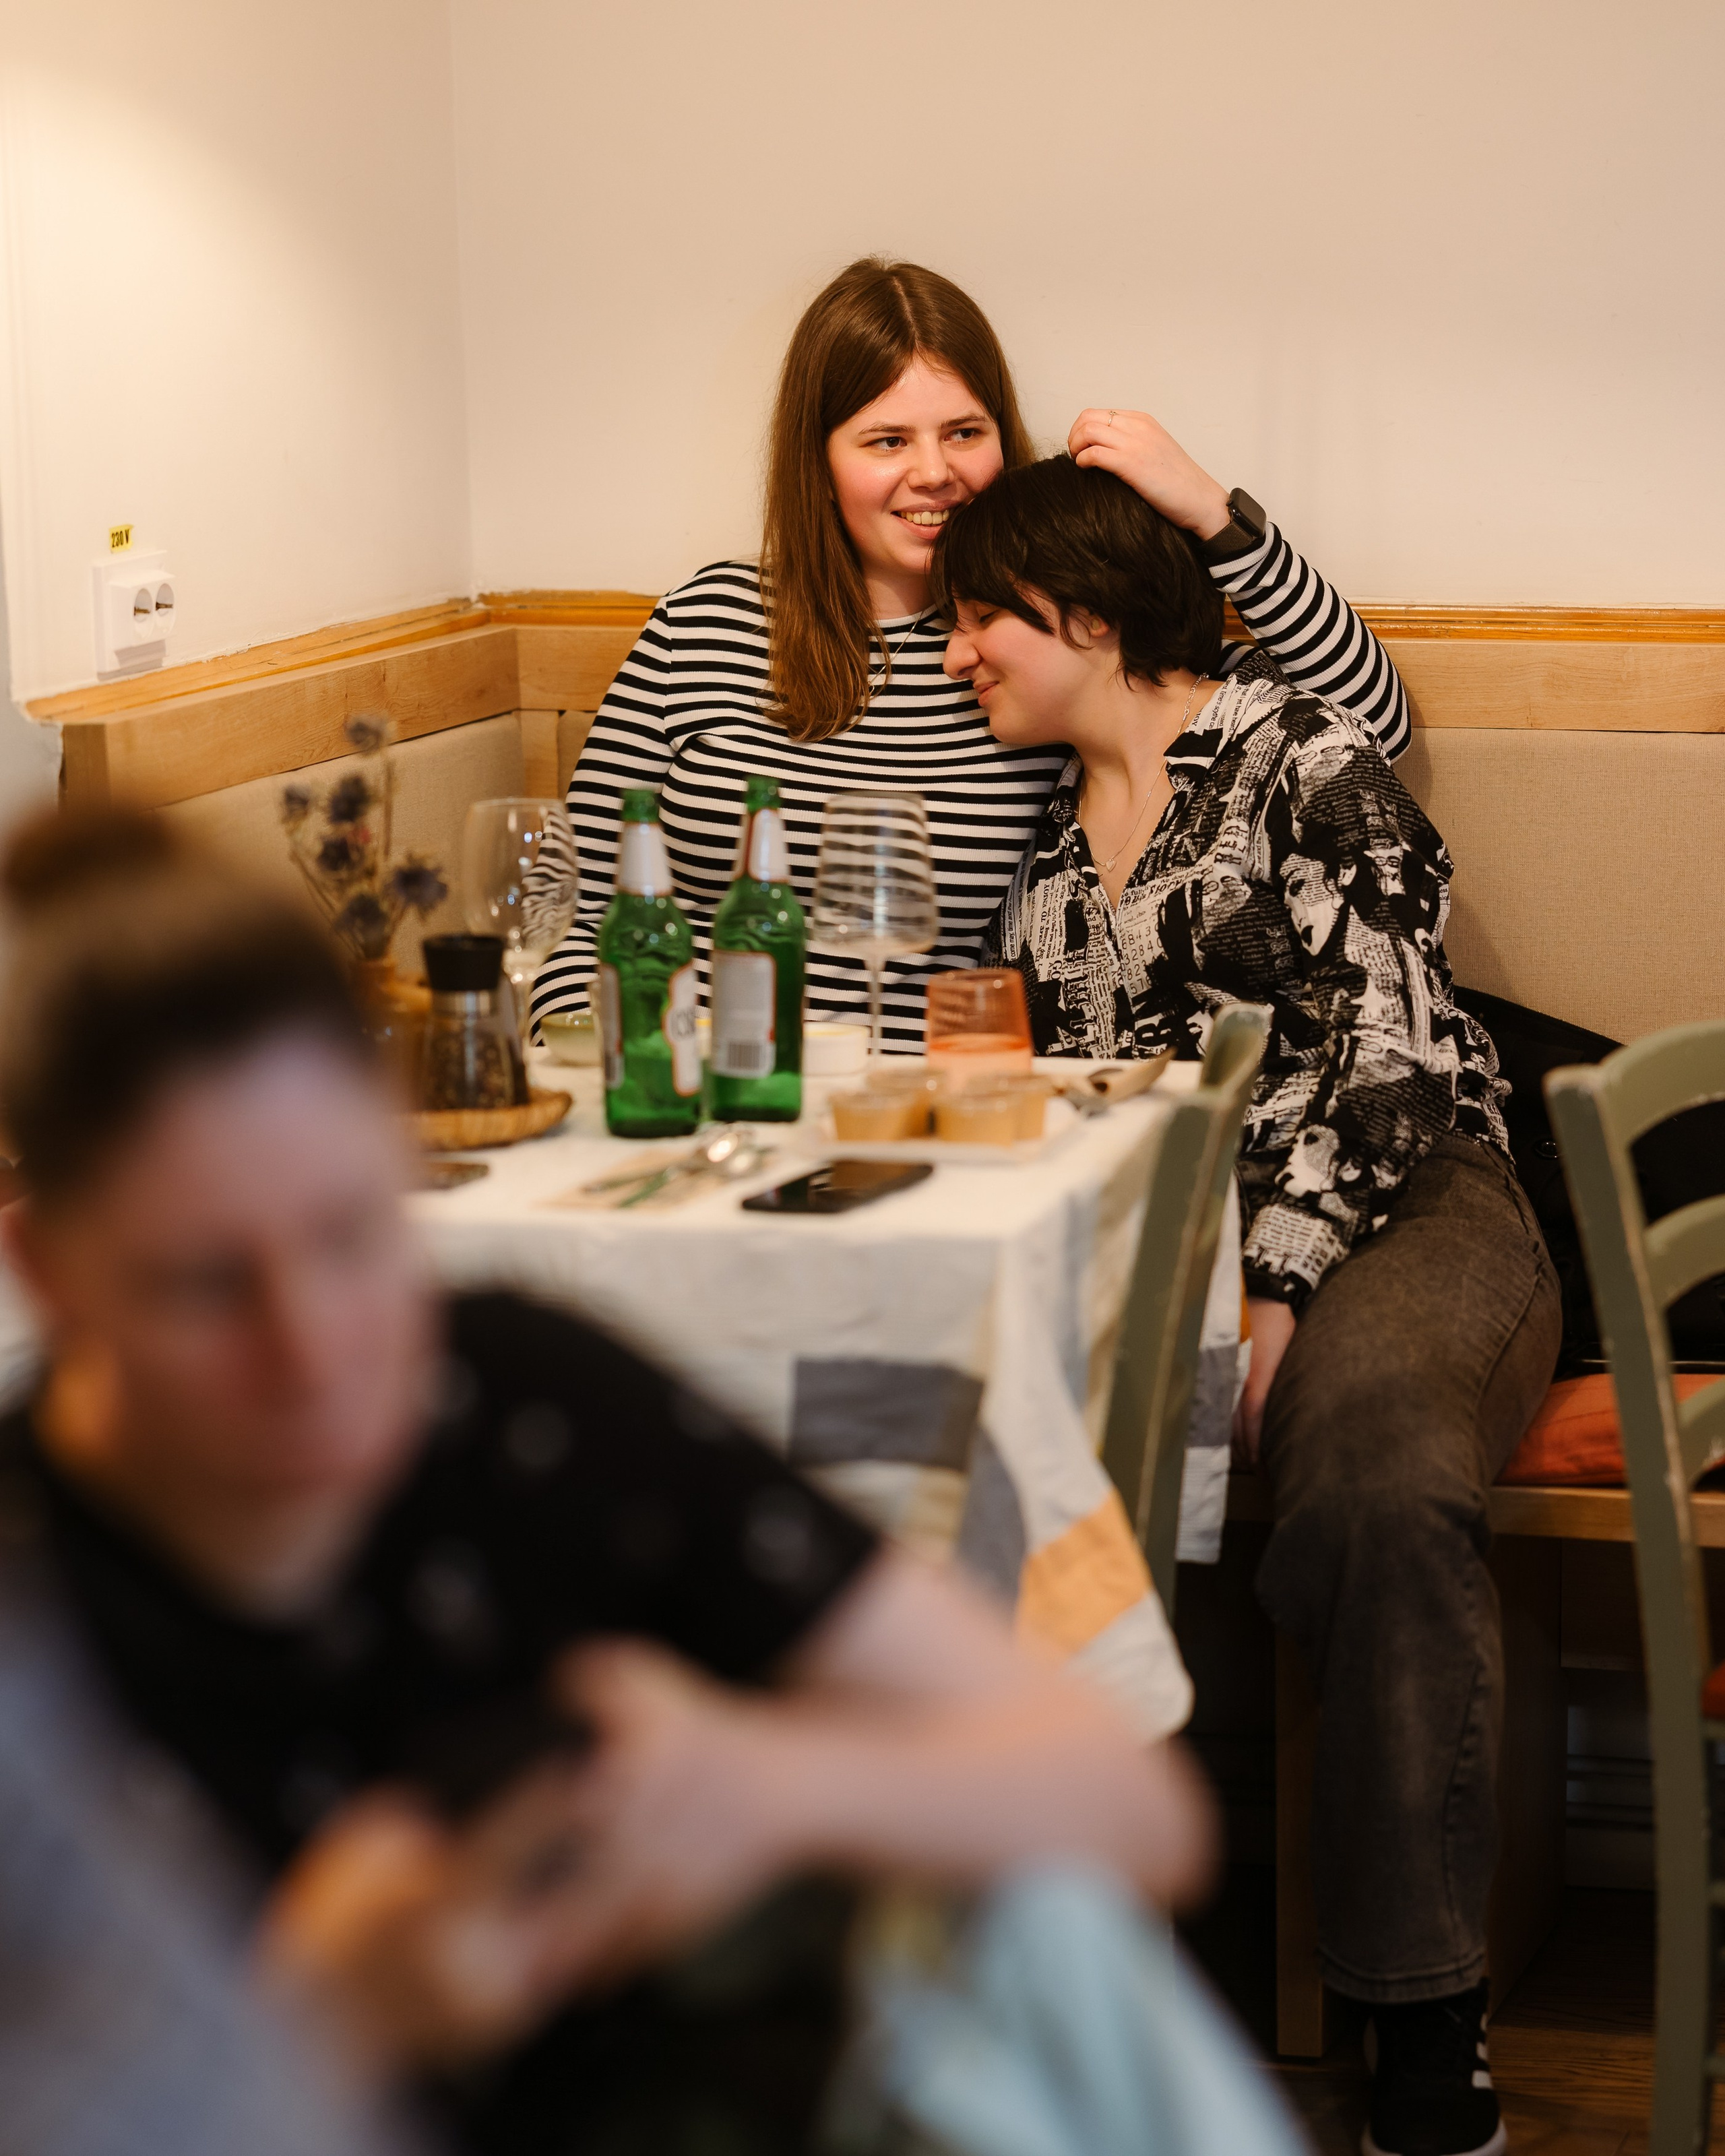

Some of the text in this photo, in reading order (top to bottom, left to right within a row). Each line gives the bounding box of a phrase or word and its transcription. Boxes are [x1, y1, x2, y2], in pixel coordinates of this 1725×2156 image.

[112, 530, 129, 548] 230 V
[1040, 911, 1048, 922] TO
